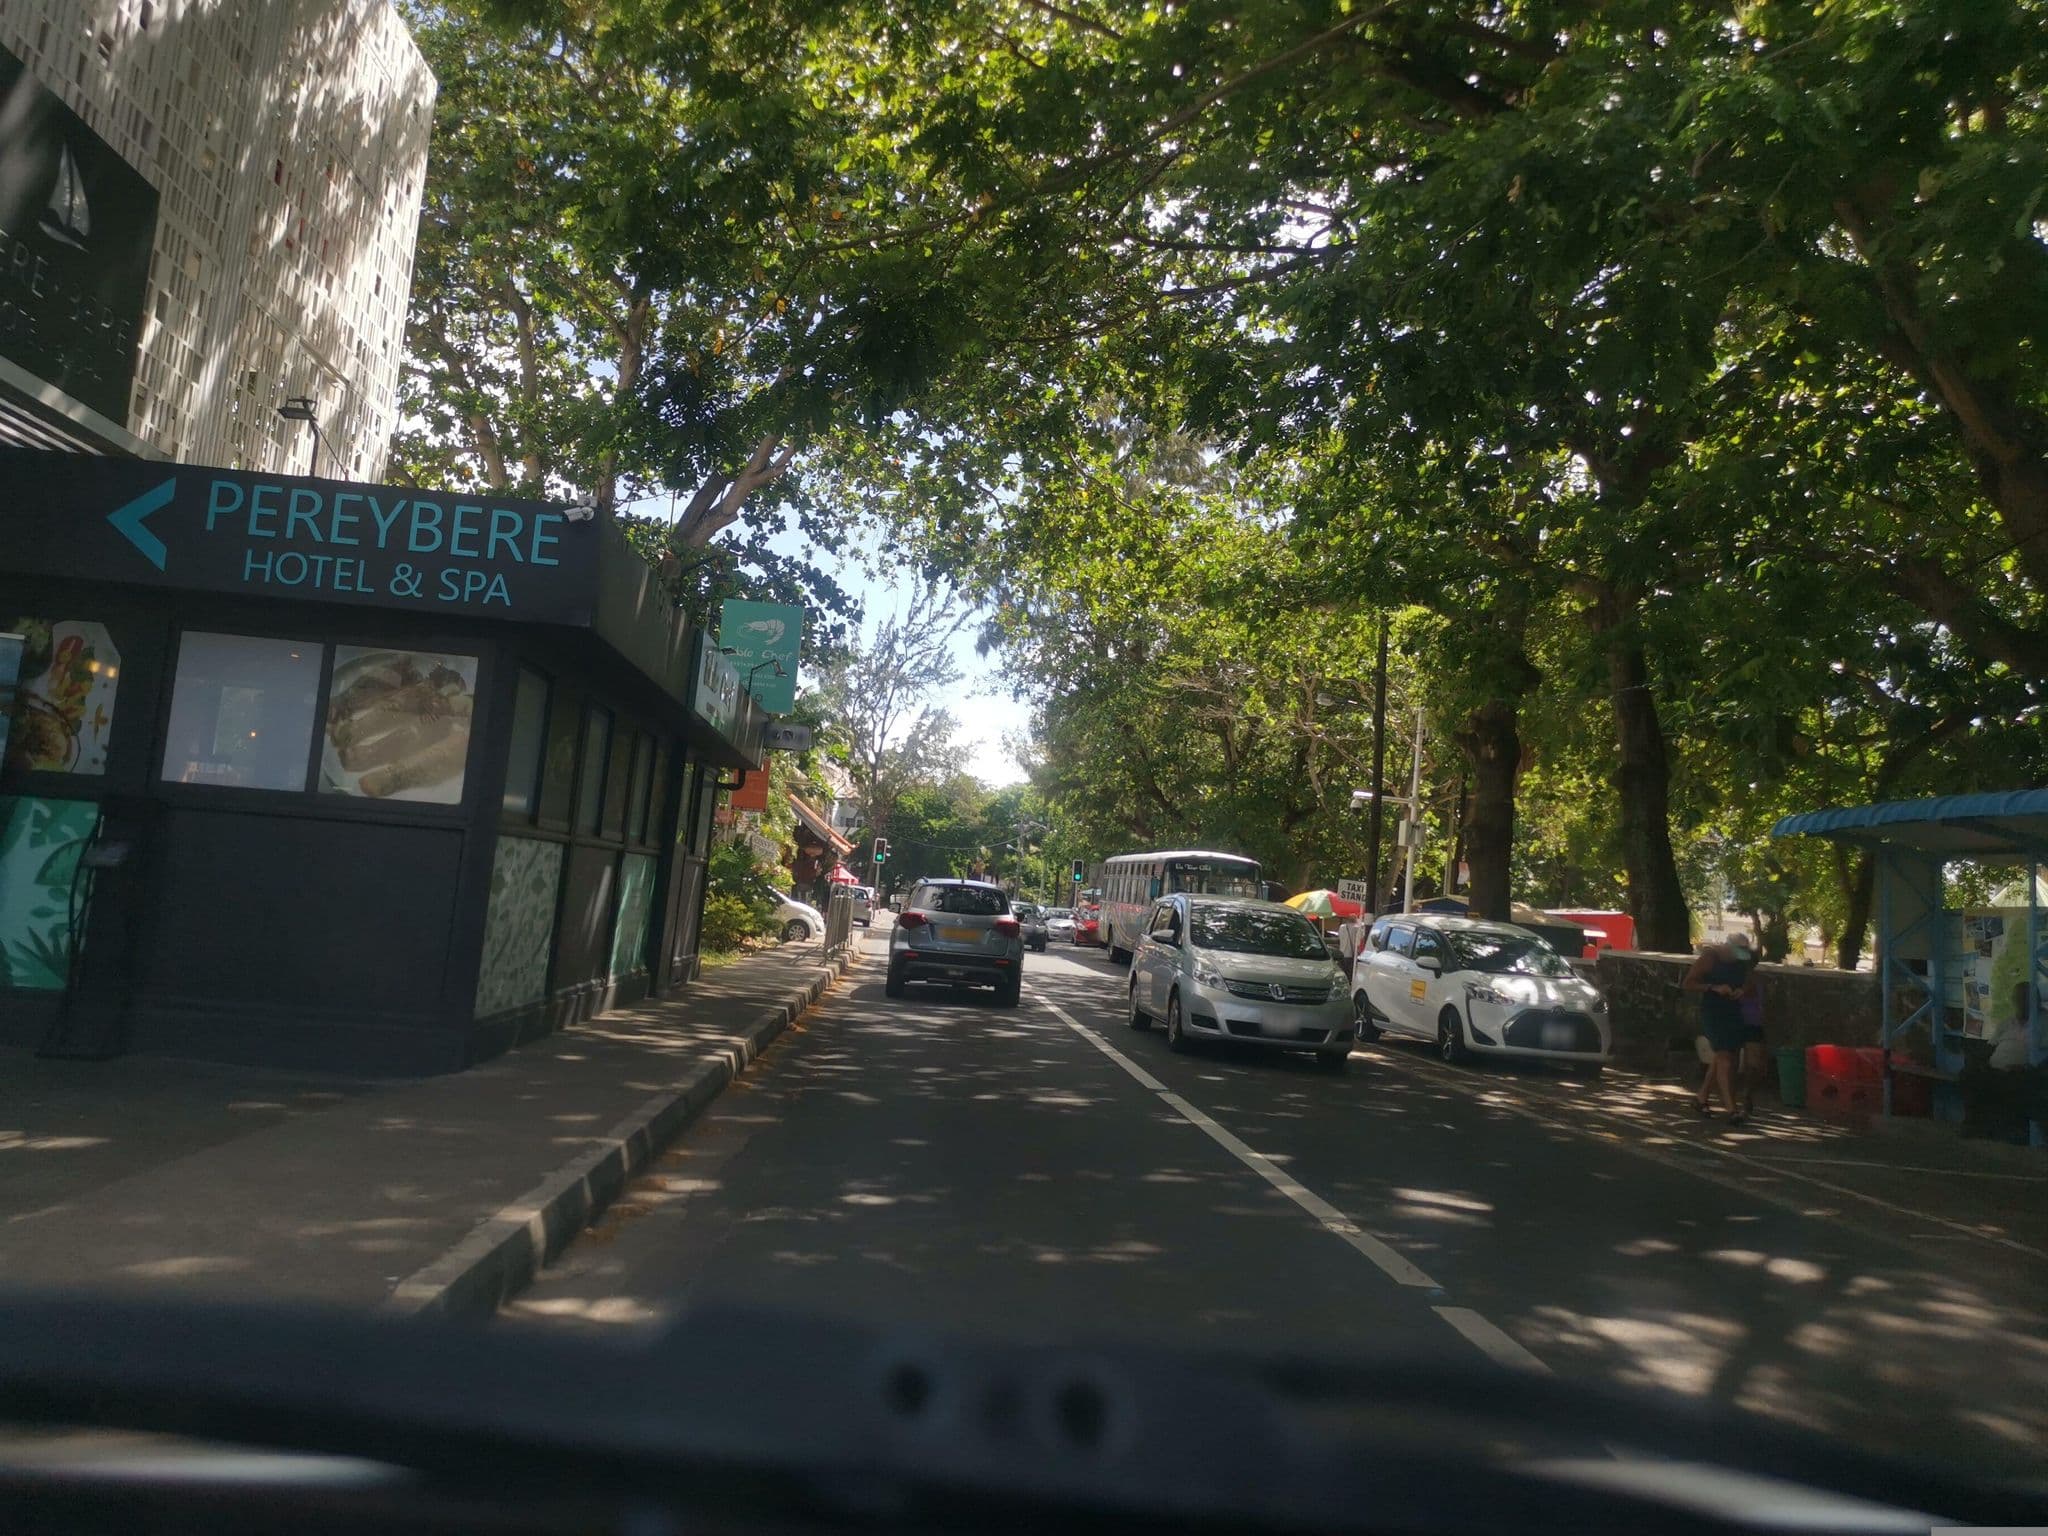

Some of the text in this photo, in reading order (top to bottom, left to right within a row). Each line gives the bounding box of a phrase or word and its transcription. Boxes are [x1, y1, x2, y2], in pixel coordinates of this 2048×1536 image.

[204, 479, 563, 567] PEREYBERE
[241, 548, 513, 607] HOTEL & SPA
[1340, 891, 1366, 901] STAND
[1346, 883, 1365, 893] TAXI
